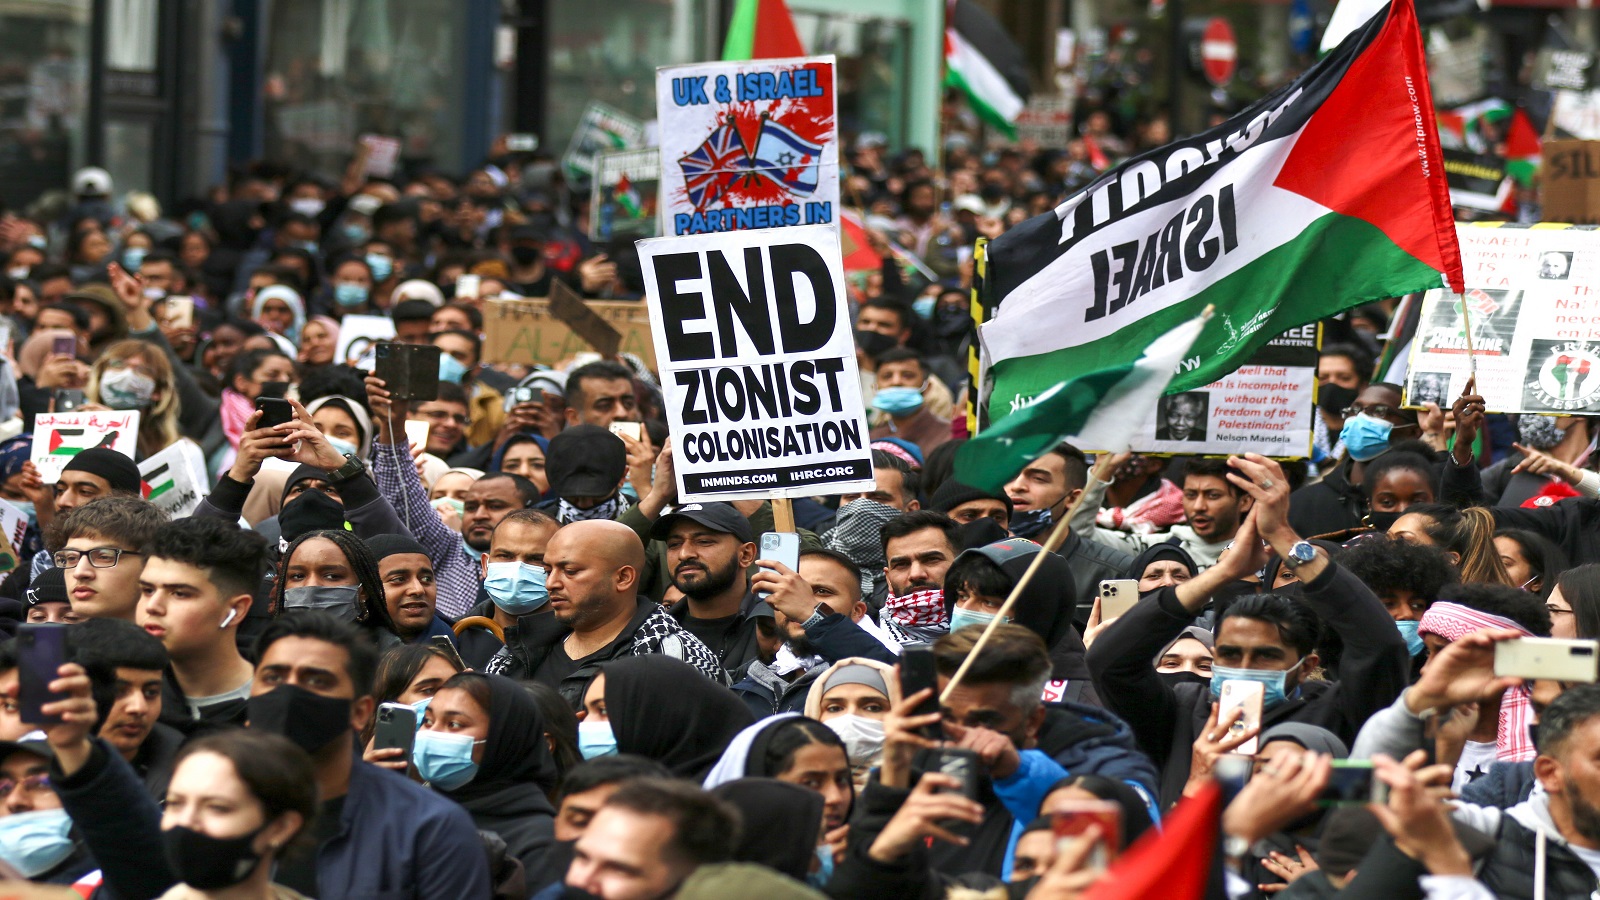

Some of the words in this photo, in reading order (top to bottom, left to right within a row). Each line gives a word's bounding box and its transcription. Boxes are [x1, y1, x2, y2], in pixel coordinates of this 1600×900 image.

[673, 75, 709, 106] UK
[715, 75, 731, 103] &
[736, 69, 823, 100] ISRAEL
[674, 205, 800, 235] PARTNERS
[805, 202, 832, 225] IN
[652, 243, 836, 362] END
[1266, 339, 1314, 347] ALESTINE
[1264, 367, 1287, 376] that
[674, 358, 844, 425] ZIONIST
[1226, 380, 1234, 389] is
[1238, 381, 1299, 391] incomplete
[1224, 395, 1268, 404] without
[1271, 396, 1288, 405] the
[1213, 407, 1260, 417] freedom
[1264, 409, 1276, 419] of
[1279, 409, 1296, 418] the
[683, 418, 862, 464] COLONISATION
[1250, 435, 1291, 443] Mandela
[701, 473, 777, 488] INMINDS.COM
[790, 466, 854, 481] IHRC.ORG
